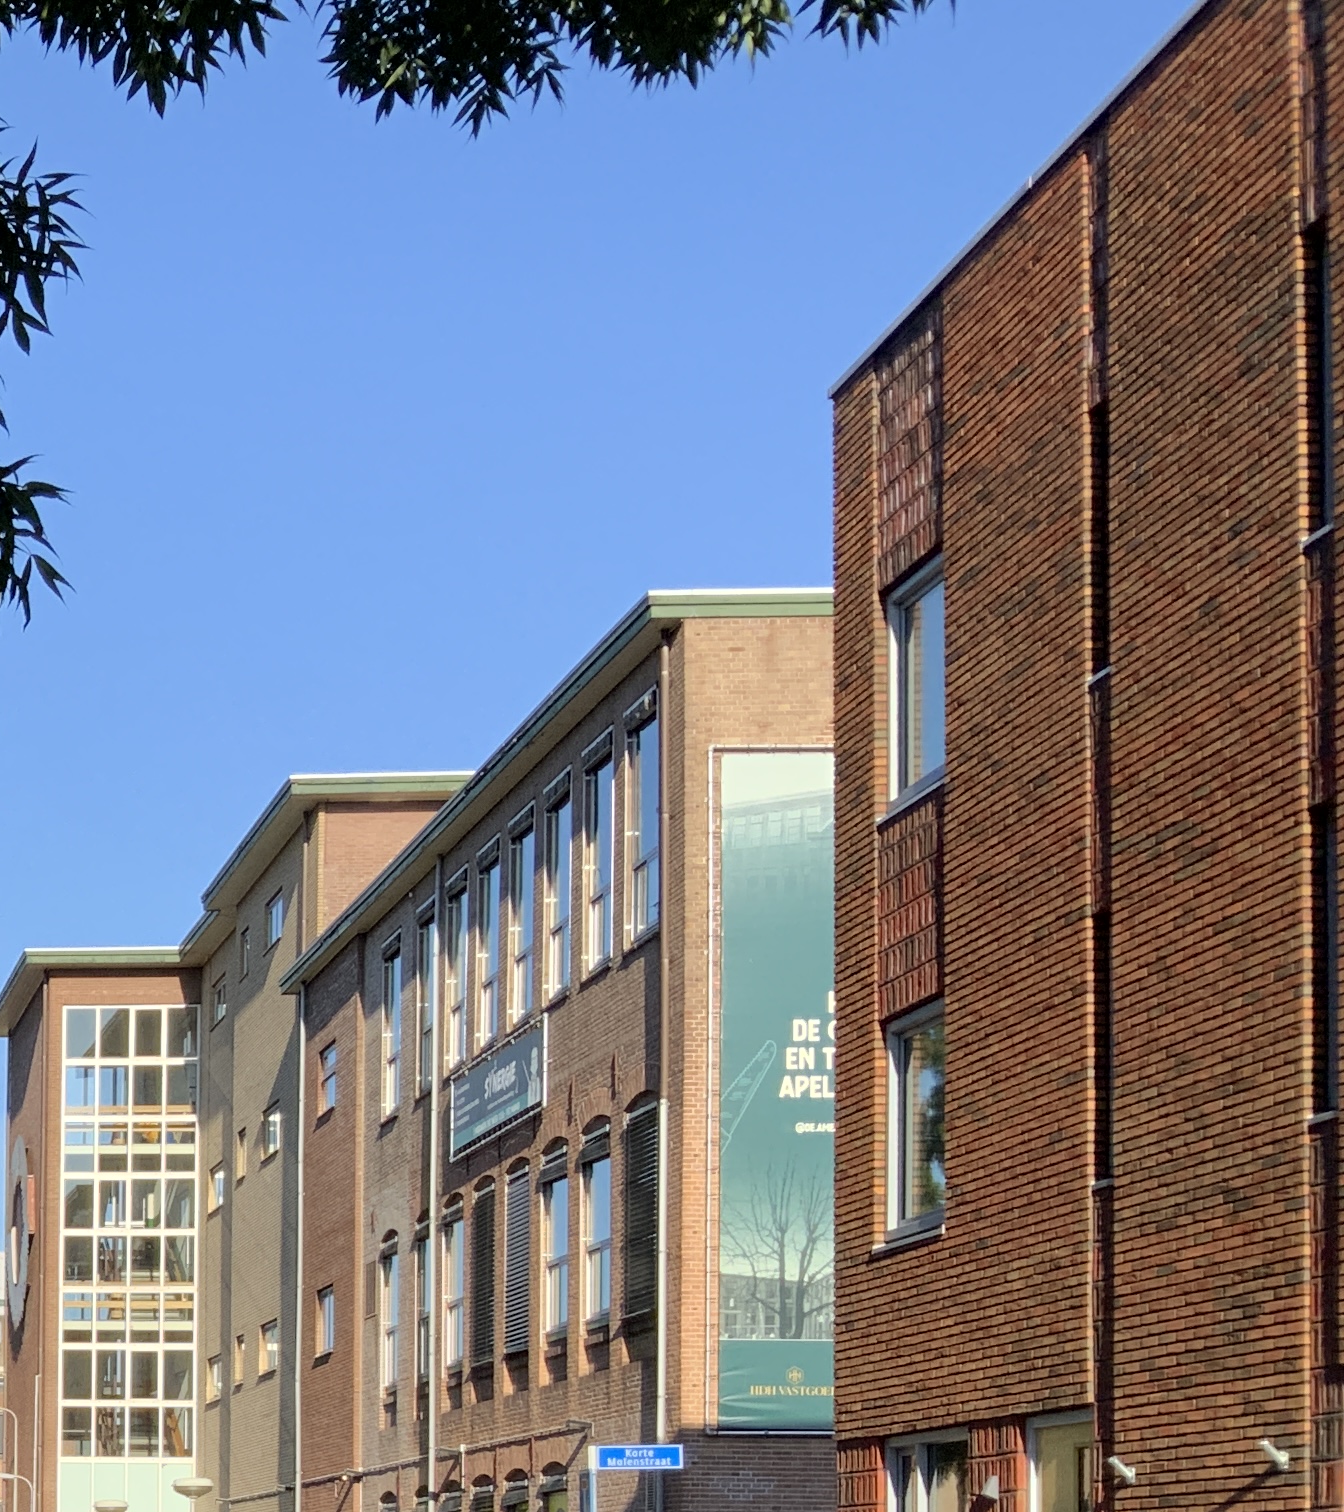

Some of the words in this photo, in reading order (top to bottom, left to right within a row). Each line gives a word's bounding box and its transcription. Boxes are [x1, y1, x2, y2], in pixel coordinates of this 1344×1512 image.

[792, 1019, 821, 1041] DE
[785, 1047, 815, 1070] EN
[625, 1449, 655, 1458] Korte
[607, 1457, 672, 1466] Molenstraat
